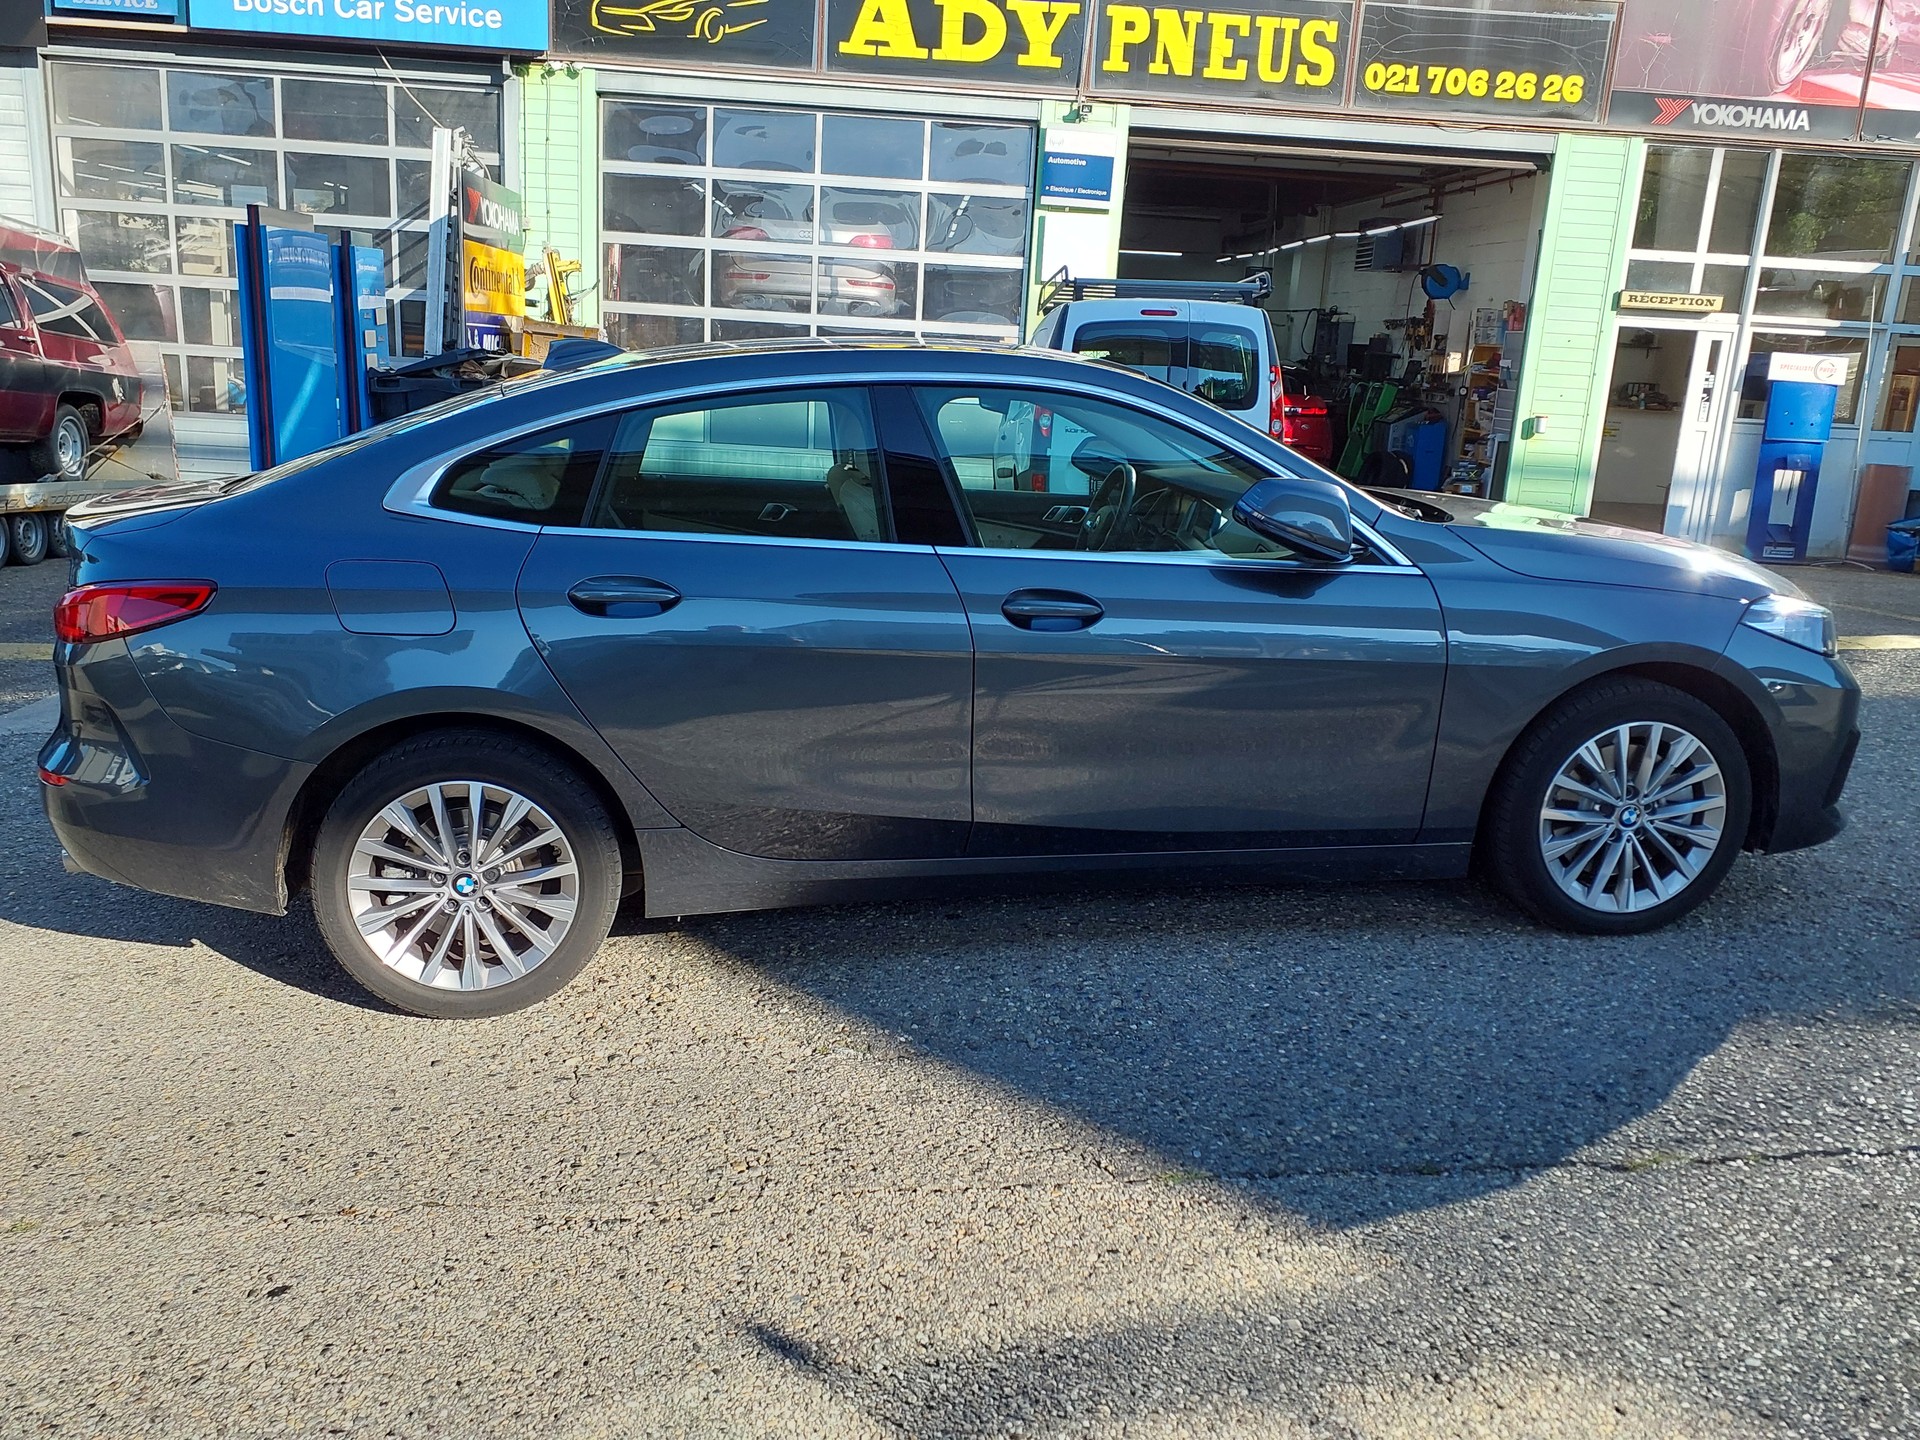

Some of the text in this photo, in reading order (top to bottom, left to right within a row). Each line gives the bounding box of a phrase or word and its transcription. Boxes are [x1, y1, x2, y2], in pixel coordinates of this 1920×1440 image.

[334, 0, 385, 20] Car
[394, 0, 503, 29] Service
[839, 0, 1339, 87] ADY PNEUS
[1364, 62, 1585, 103] 021 706 26 26
[1691, 102, 1811, 131] YOKOHAMA
[1047, 156, 1087, 166] Automotive
[480, 196, 520, 237] YOKOHAMA
[469, 256, 516, 298] Continental
